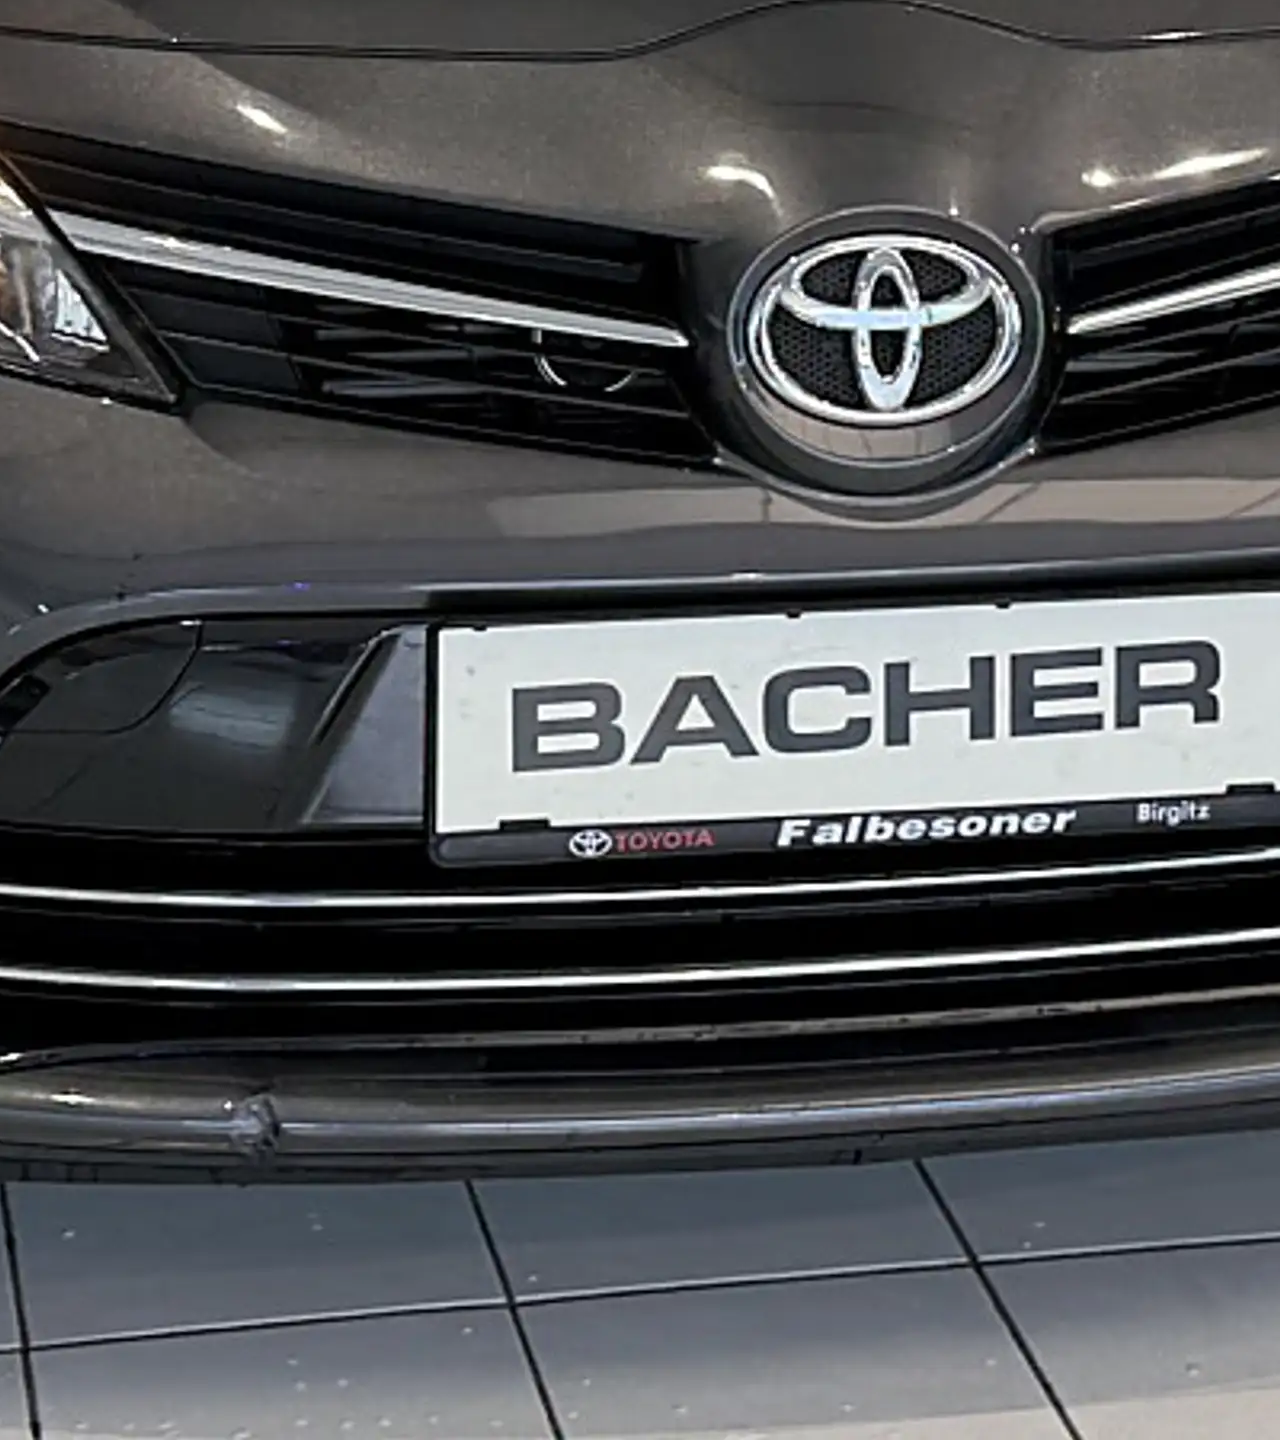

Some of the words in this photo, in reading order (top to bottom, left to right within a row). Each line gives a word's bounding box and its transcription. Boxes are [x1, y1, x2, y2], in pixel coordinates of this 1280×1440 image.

[512, 640, 1221, 772] BACHER
[615, 829, 715, 853] TOYOTA
[776, 809, 1076, 847] Falbesoner
[1136, 800, 1211, 825] Birgitz
